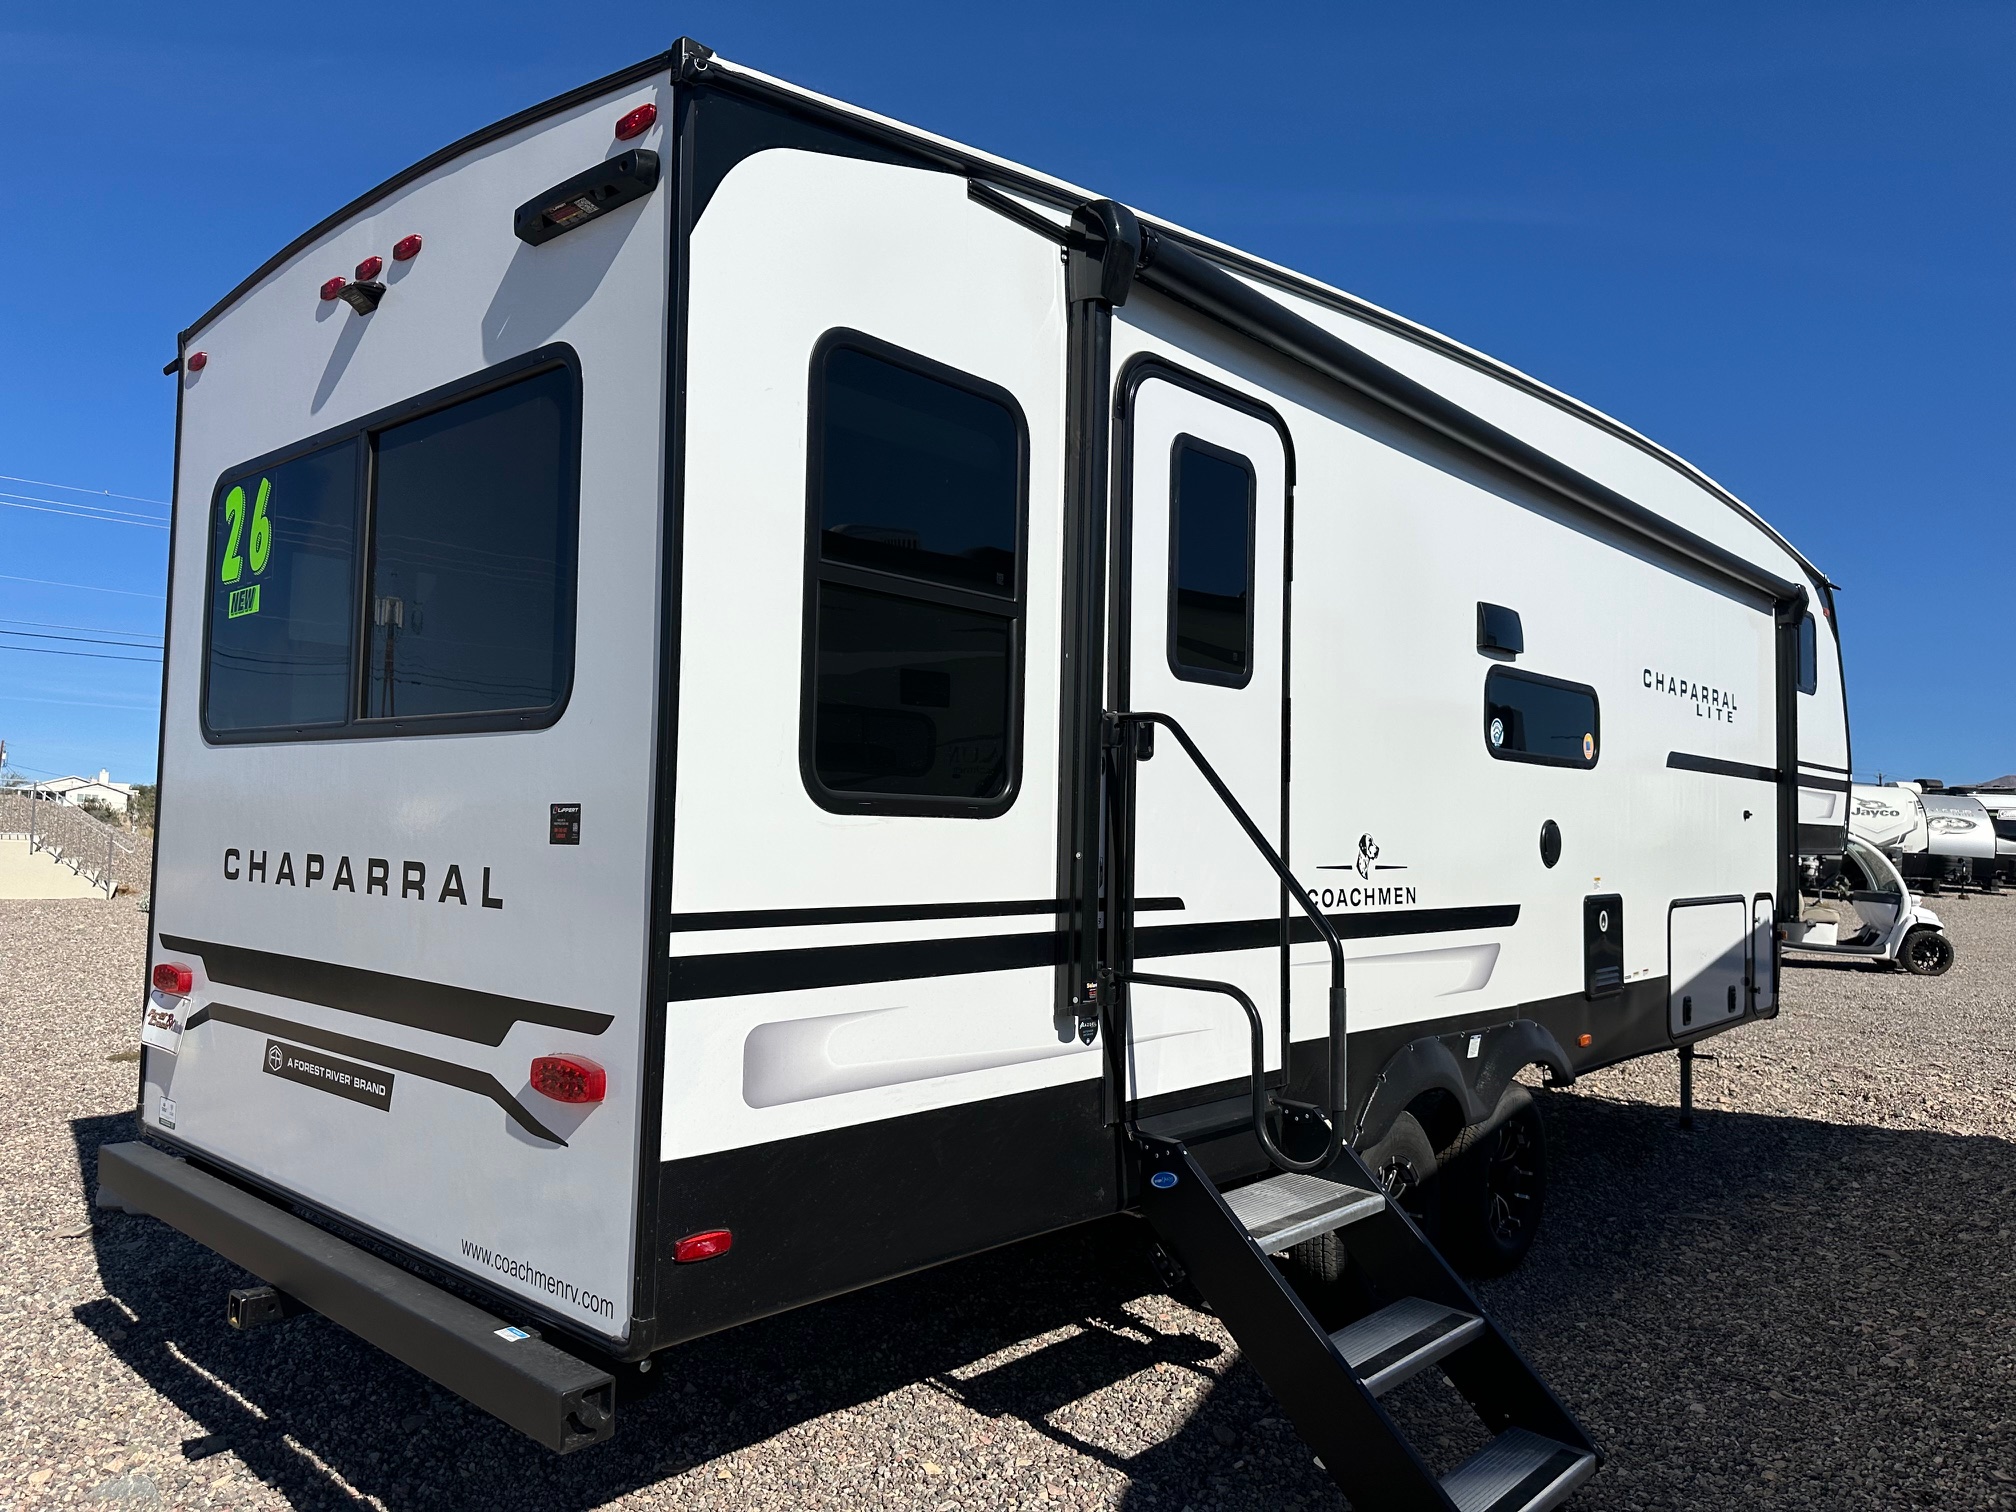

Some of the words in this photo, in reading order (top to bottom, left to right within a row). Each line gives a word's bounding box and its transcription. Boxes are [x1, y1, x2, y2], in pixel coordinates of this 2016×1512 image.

[221, 477, 272, 585] 26
[230, 587, 257, 616] NEW
[1643, 668, 1738, 711] CHAPARRAL
[1696, 703, 1734, 724] LITE
[1851, 807, 1900, 818] Jayco
[223, 848, 504, 910] CHAPARRAL
[1306, 886, 1416, 908] COACHMEN
[287, 1057, 294, 1068] A
[293, 1059, 325, 1077] FOREST
[353, 1077, 386, 1096] BRAND
[461, 1238, 614, 1320] www.coachmenrv.com
